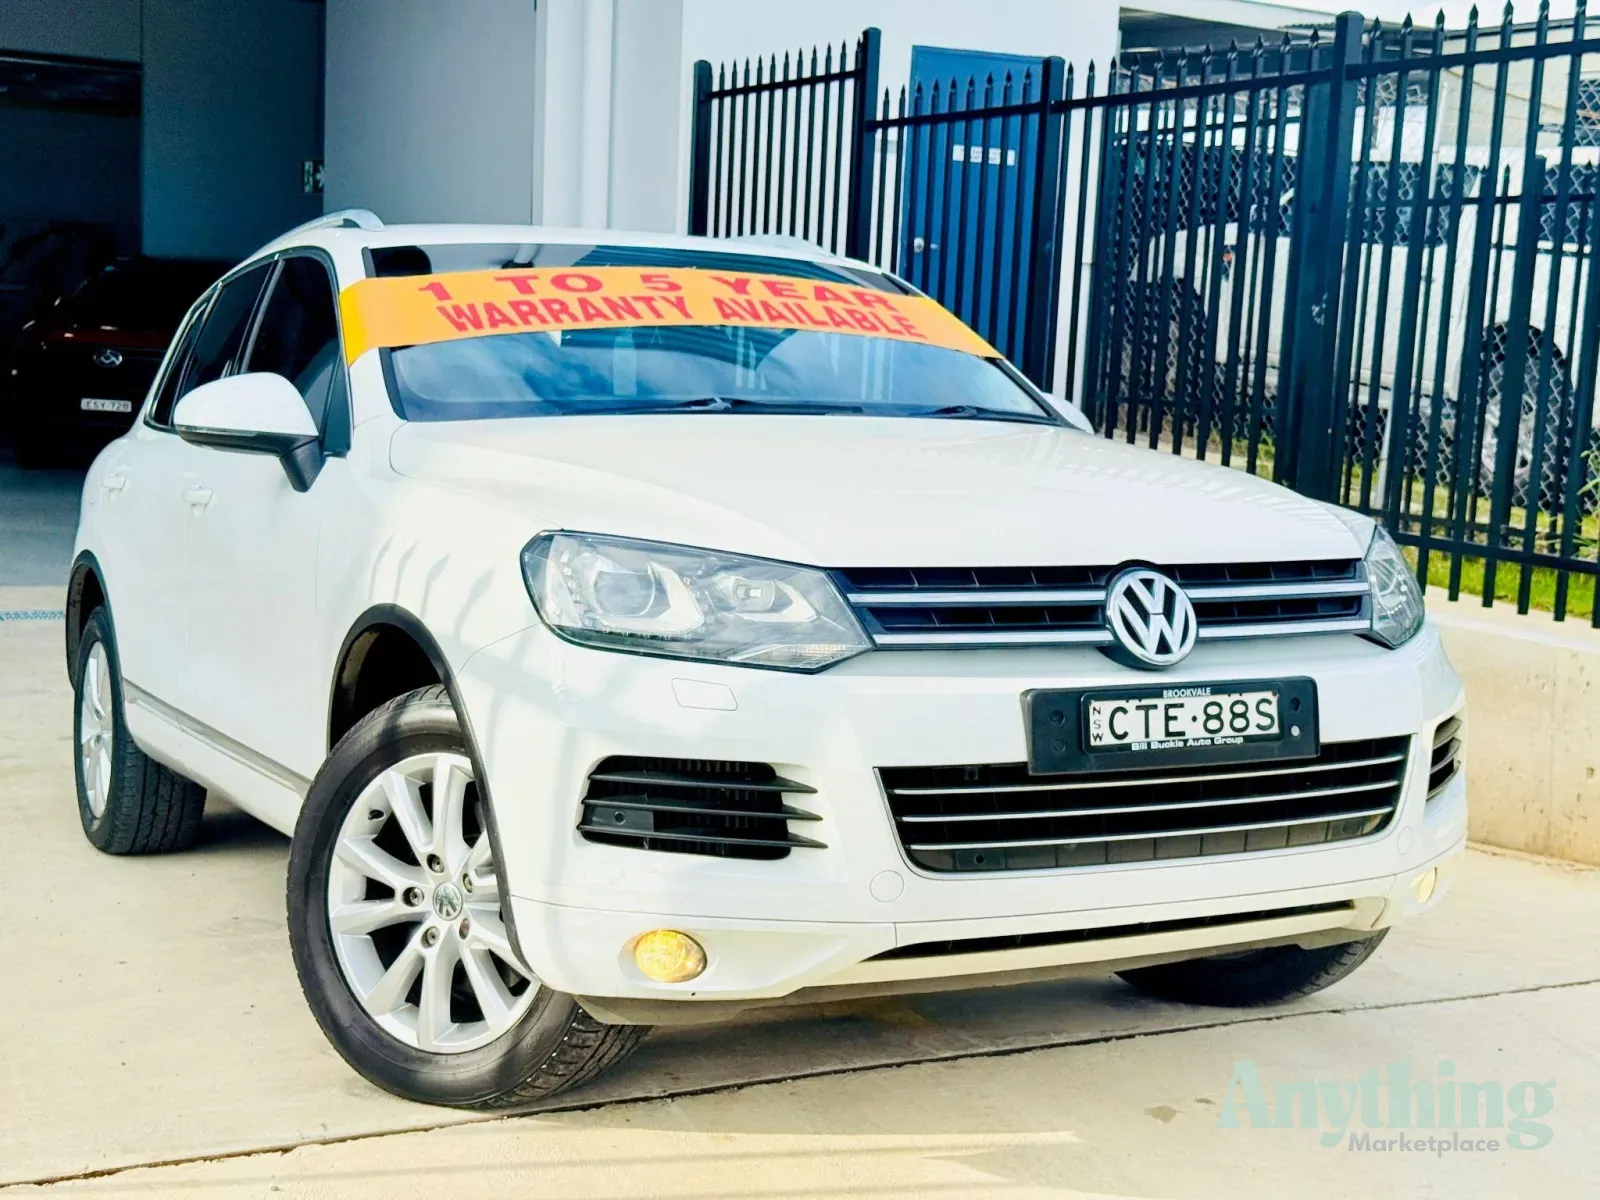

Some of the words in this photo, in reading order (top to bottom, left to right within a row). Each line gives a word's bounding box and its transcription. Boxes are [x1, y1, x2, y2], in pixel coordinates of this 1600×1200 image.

[418, 282, 453, 301] 1
[494, 273, 604, 295] TO
[639, 274, 682, 292] 5
[709, 276, 898, 313] YEAR
[436, 296, 693, 332] WARRANTY
[713, 297, 928, 339] AVAILABLE
[1110, 571, 1196, 664] VW
[1163, 687, 1211, 698] BROOKVALE
[1131, 742, 1148, 751] Bill
[1151, 740, 1184, 750] Buckle
[1187, 738, 1211, 747] Auto
[1214, 736, 1244, 745] Group
